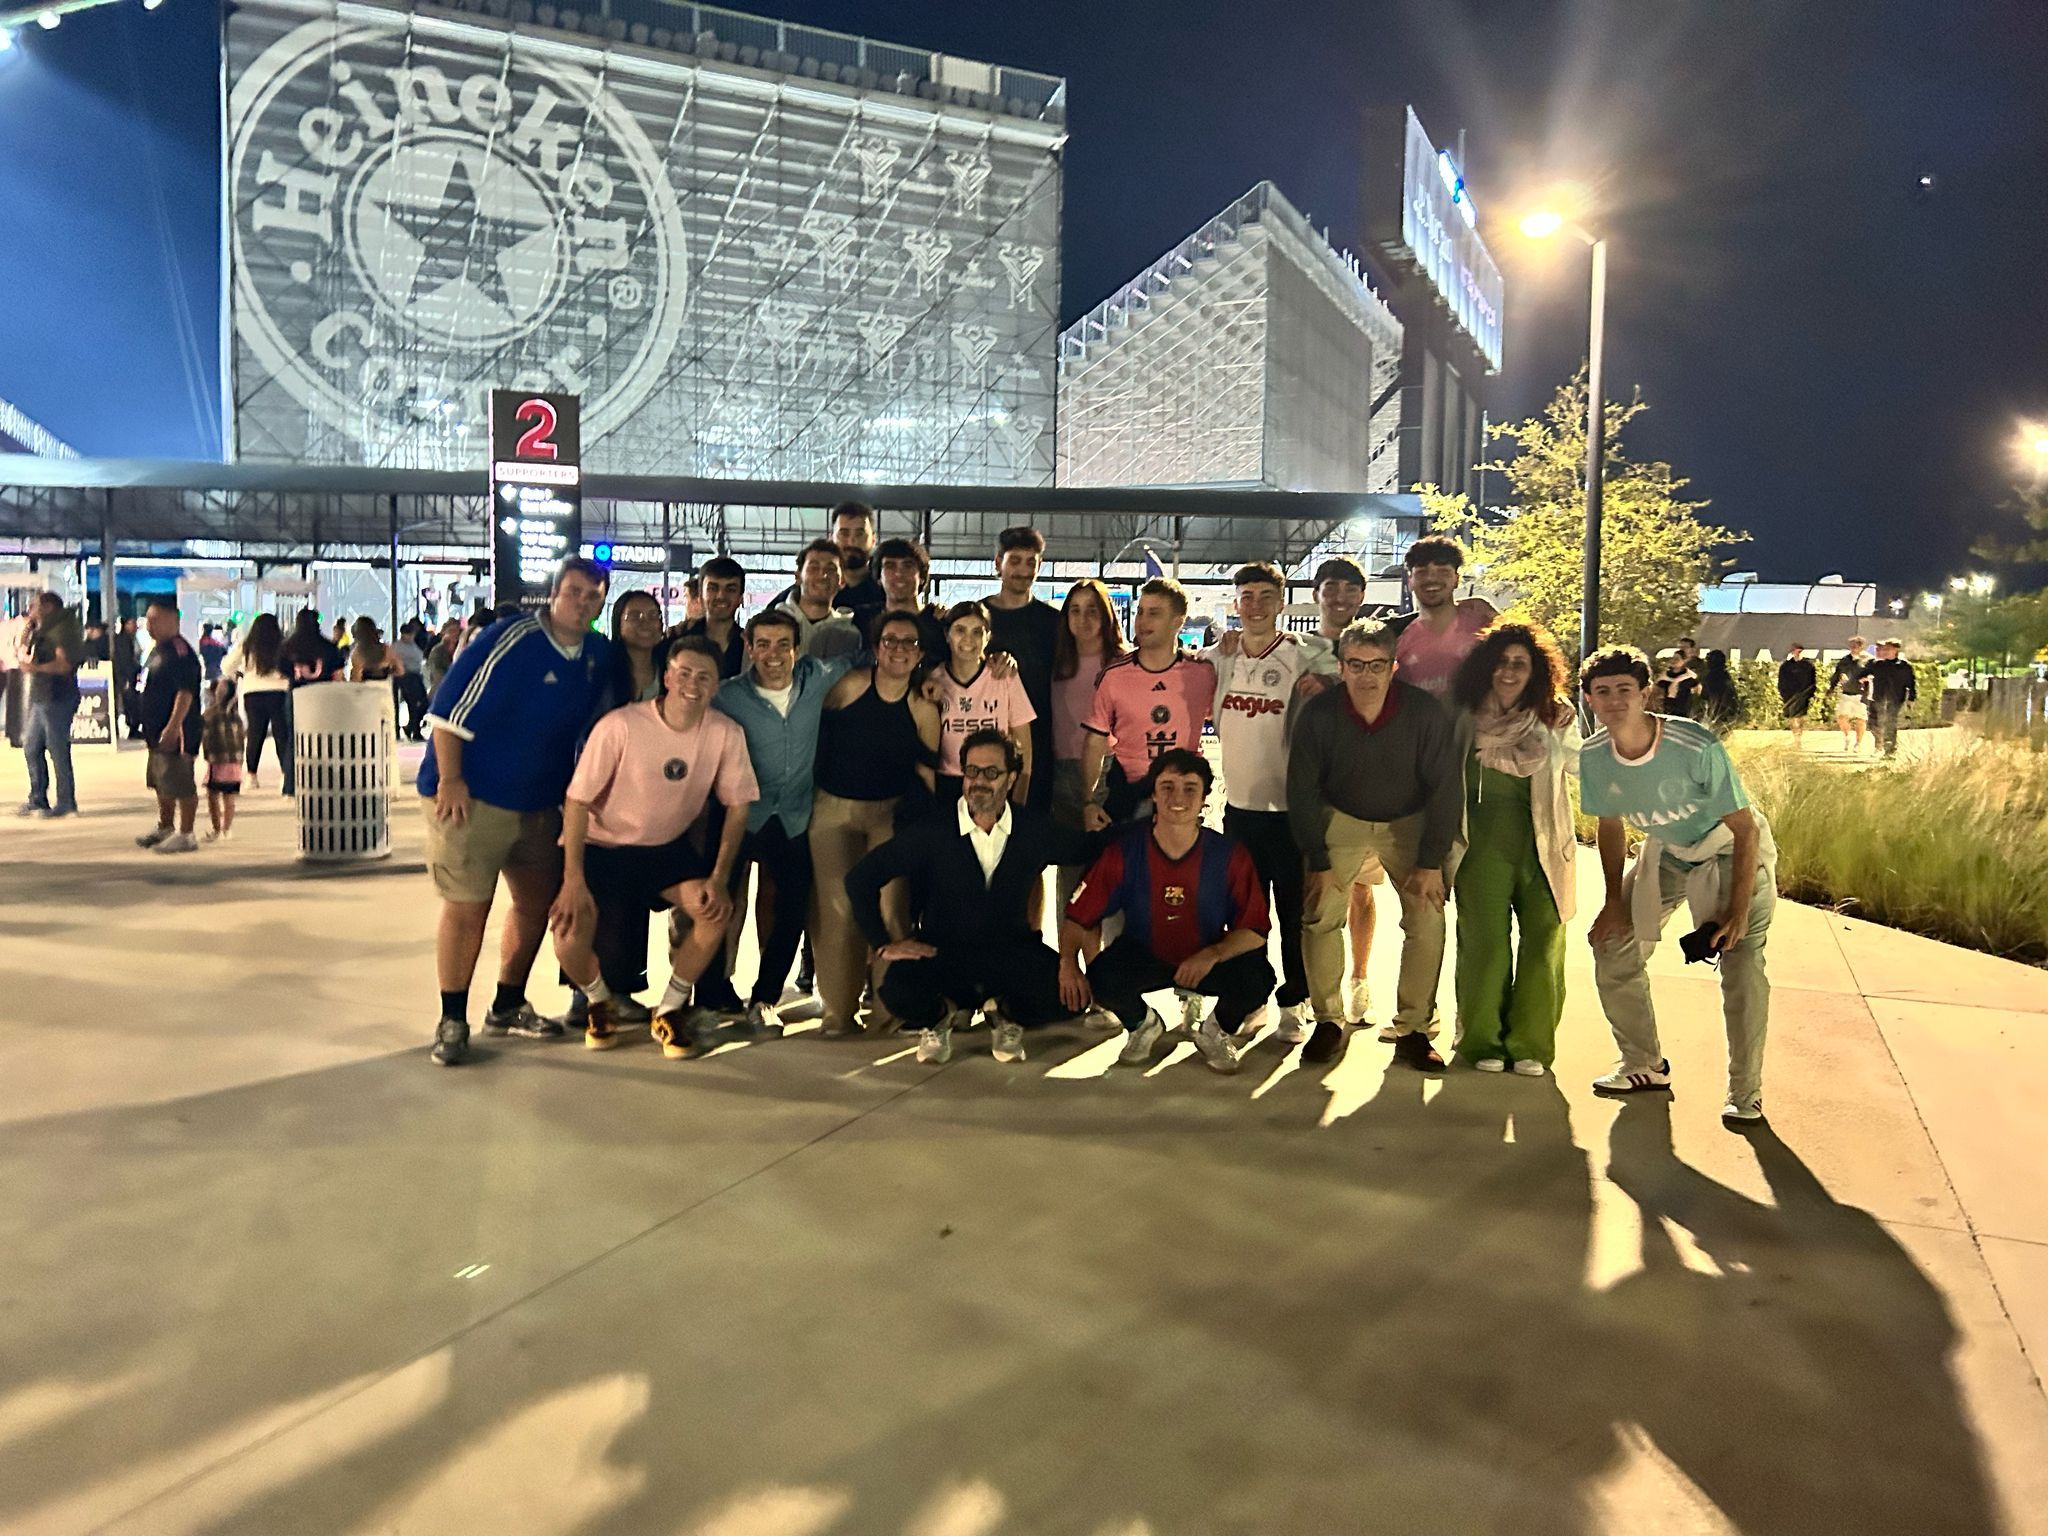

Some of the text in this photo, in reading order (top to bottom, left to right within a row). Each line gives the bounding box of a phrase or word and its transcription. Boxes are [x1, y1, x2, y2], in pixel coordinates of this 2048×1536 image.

[252, 61, 629, 274] Heineken
[514, 398, 558, 460] 2
[499, 467, 576, 480] SUPPORTERS
